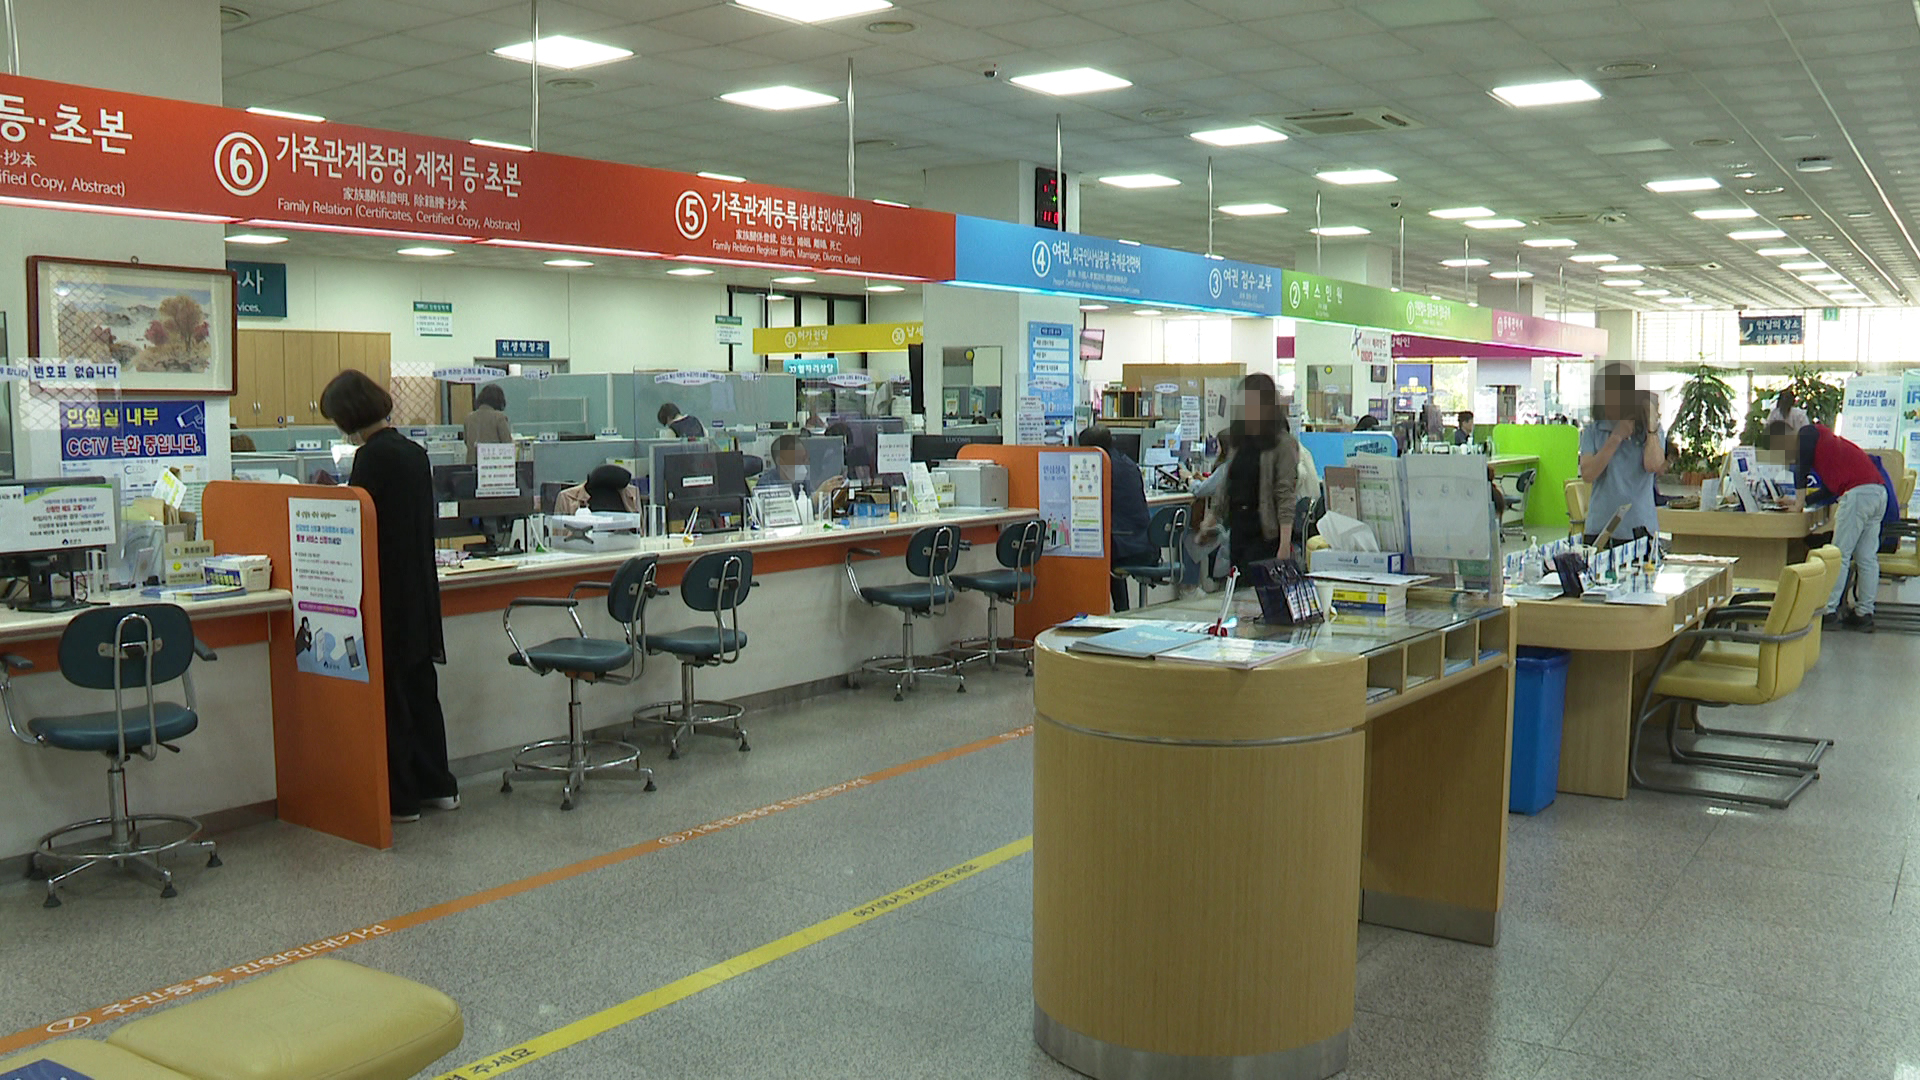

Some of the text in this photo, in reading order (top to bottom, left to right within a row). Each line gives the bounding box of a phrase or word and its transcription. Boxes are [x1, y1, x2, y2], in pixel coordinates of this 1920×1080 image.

[276, 132, 412, 186] 가족관계증명,
[415, 151, 454, 192] 제적
[460, 156, 522, 198] 등·초본
[31, 173, 67, 192] Copy,
[71, 177, 126, 197] Abstract)
[278, 198, 521, 232] Family Relation (Certificates, Certified Copy, Abstract)
[712, 238, 731, 254] Family
[732, 241, 756, 254] Relation
[756, 243, 779, 257] Register
[779, 245, 796, 259] (Birth,
[822, 249, 843, 263] Divorce,
[1223, 267, 1239, 288] 여권
[502, 341, 544, 352] 위생행정과
[33, 365, 117, 379] 번호표 없습니다
[1856, 389, 1887, 398] 군산사랑
[67, 407, 159, 429] 민원실 내부
[66, 433, 202, 457] CCTV 녹화 중입니다.
[101, 974, 224, 1016] 주민등록
[230, 924, 391, 975] 민원인대기선
[468, 1048, 537, 1075] 주세요
